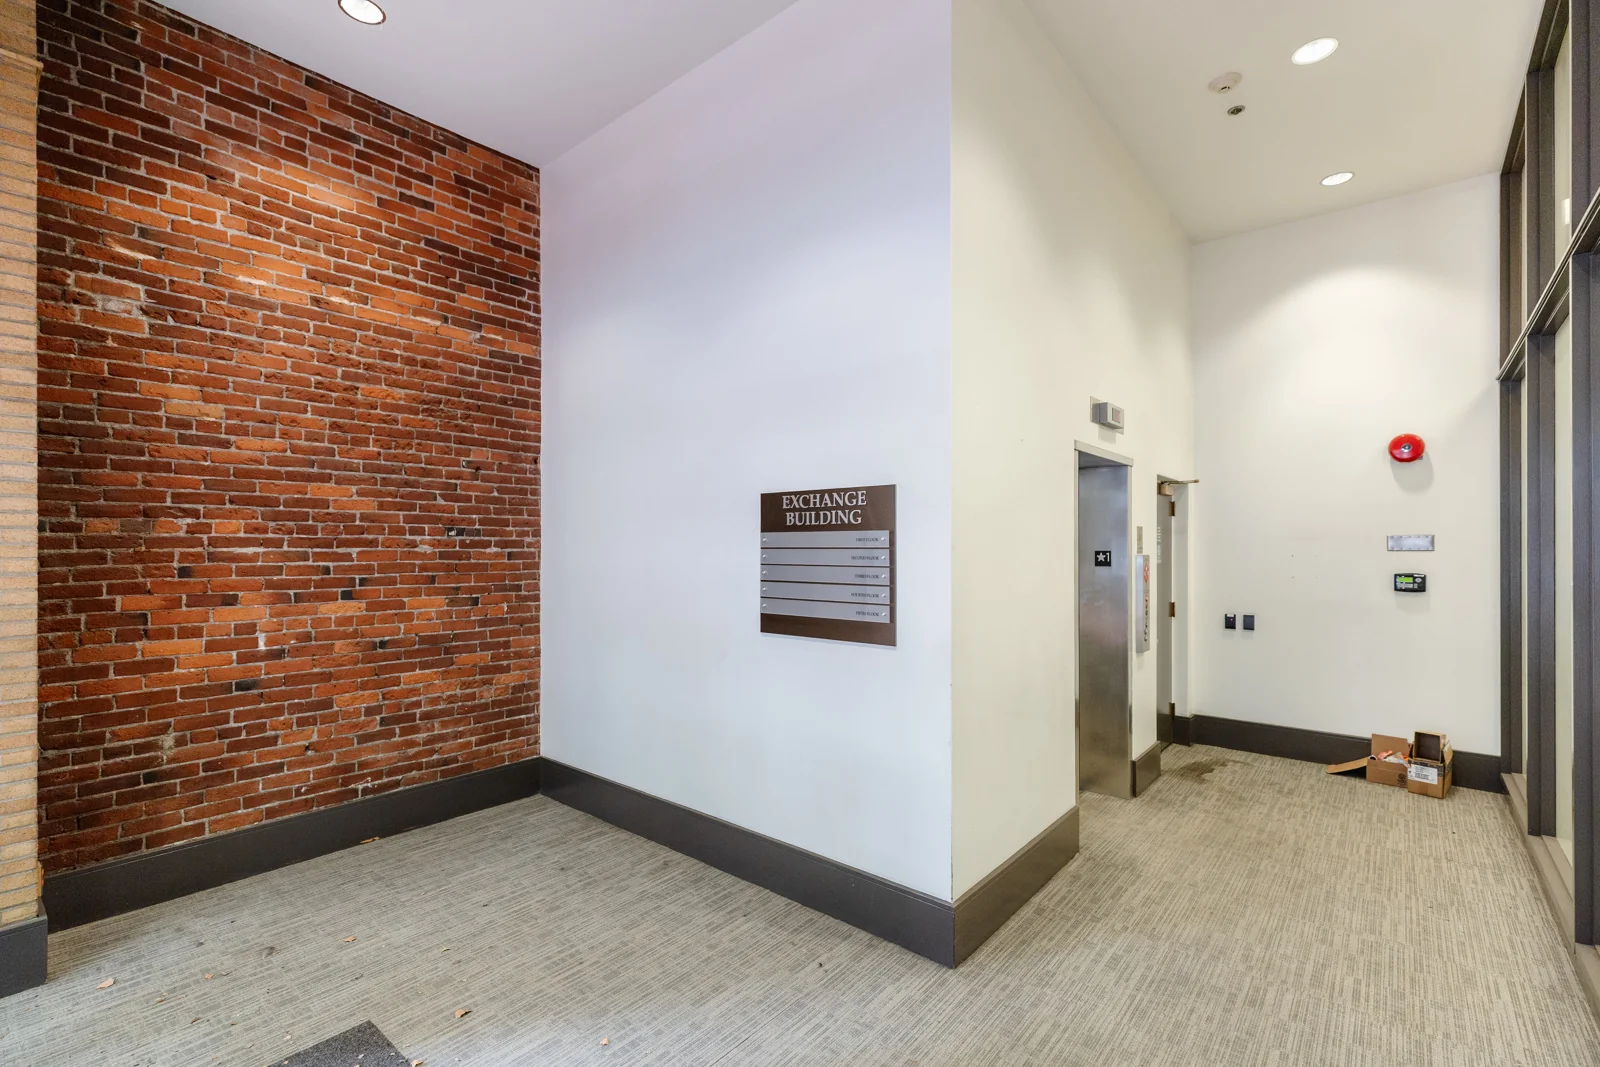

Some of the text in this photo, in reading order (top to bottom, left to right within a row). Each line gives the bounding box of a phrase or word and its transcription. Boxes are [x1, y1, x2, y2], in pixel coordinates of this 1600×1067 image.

[782, 490, 867, 510] EXCHANGE
[785, 509, 862, 526] BUILDING
[1105, 552, 1110, 562] 1
